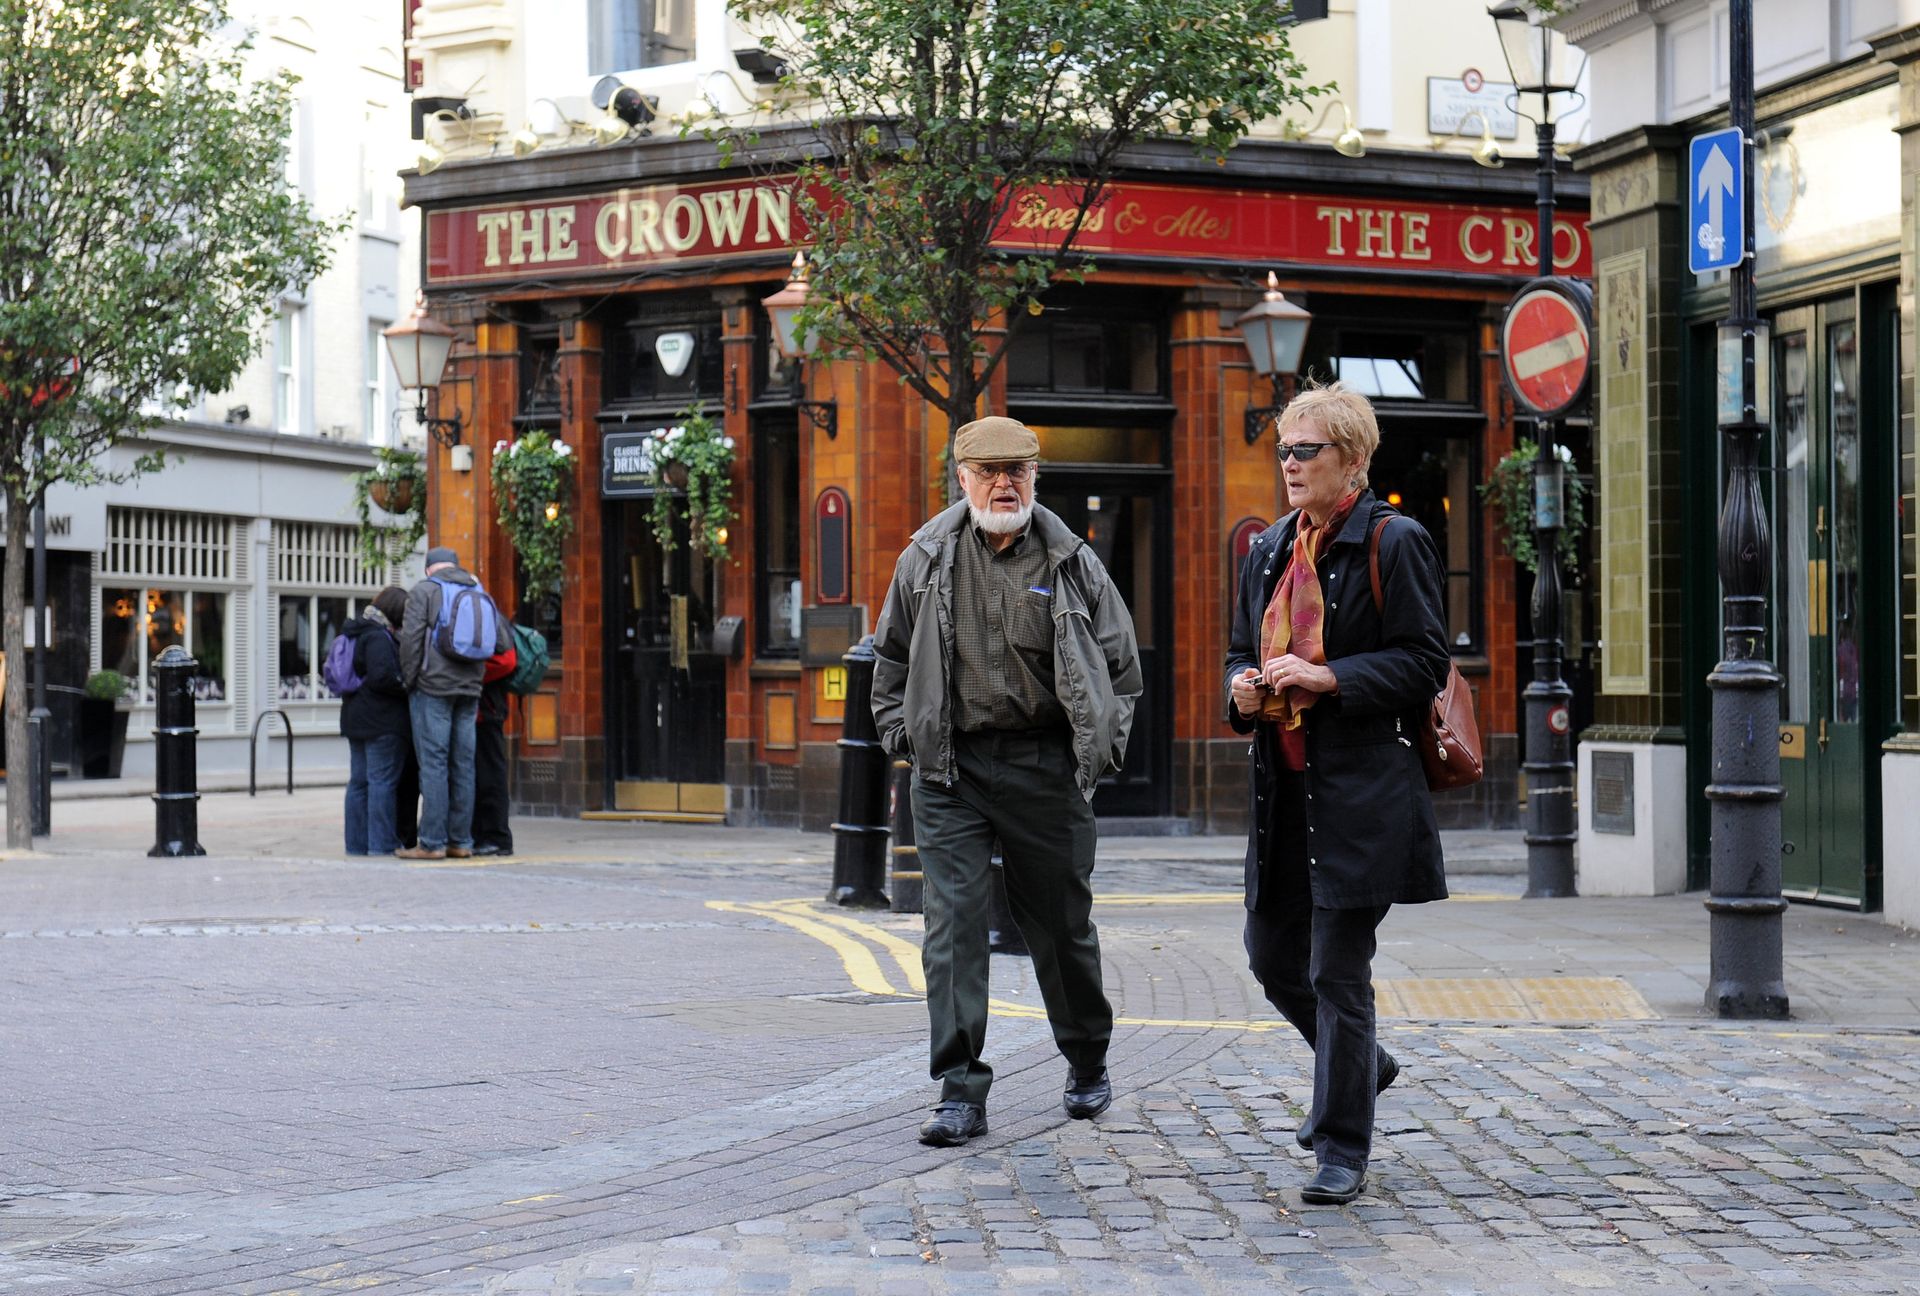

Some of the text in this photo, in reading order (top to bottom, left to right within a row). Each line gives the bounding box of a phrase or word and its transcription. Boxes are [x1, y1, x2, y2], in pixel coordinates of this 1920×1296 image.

[477, 184, 792, 267] THE CROWN
[1113, 201, 1146, 235] &
[1153, 206, 1232, 240] Ales
[1317, 206, 1593, 269] THE CRO
[827, 668, 841, 697] H
